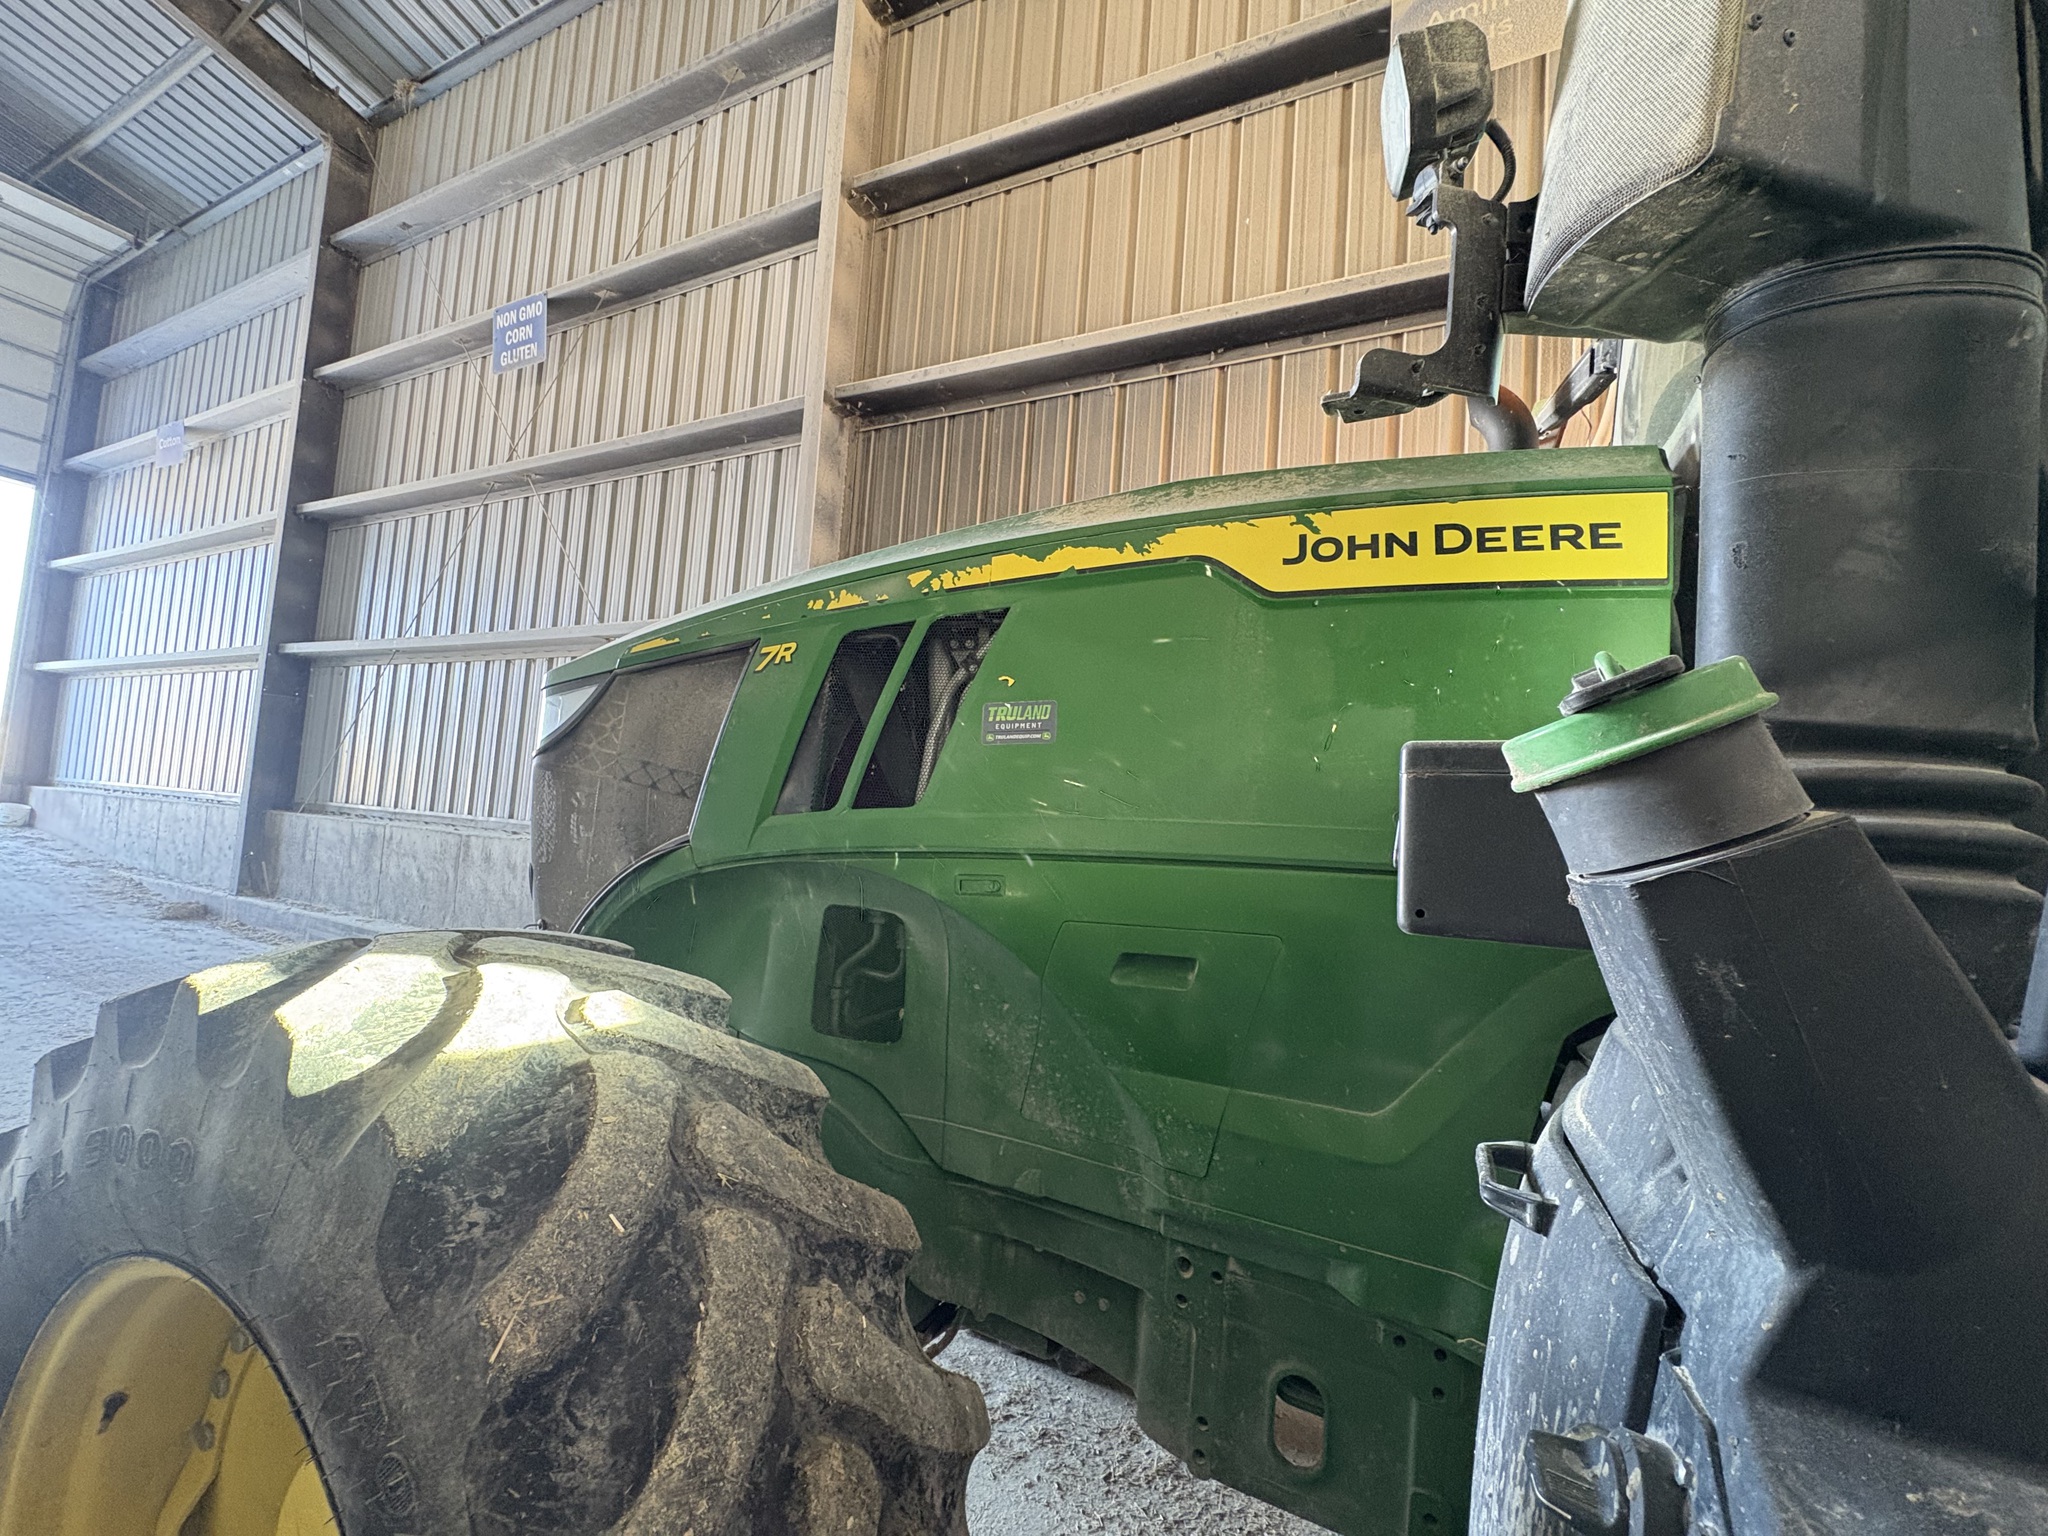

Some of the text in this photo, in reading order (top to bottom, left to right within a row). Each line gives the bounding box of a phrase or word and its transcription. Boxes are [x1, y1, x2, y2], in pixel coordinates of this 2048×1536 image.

[496, 300, 543, 330] NON GMO
[505, 323, 533, 346] CORN
[500, 342, 538, 367] GLUTEN
[1282, 522, 1624, 566] JOHN DEERE
[754, 641, 798, 673] 7R
[988, 703, 1052, 722] TRULAND
[995, 722, 1042, 730] EQUIPMENT
